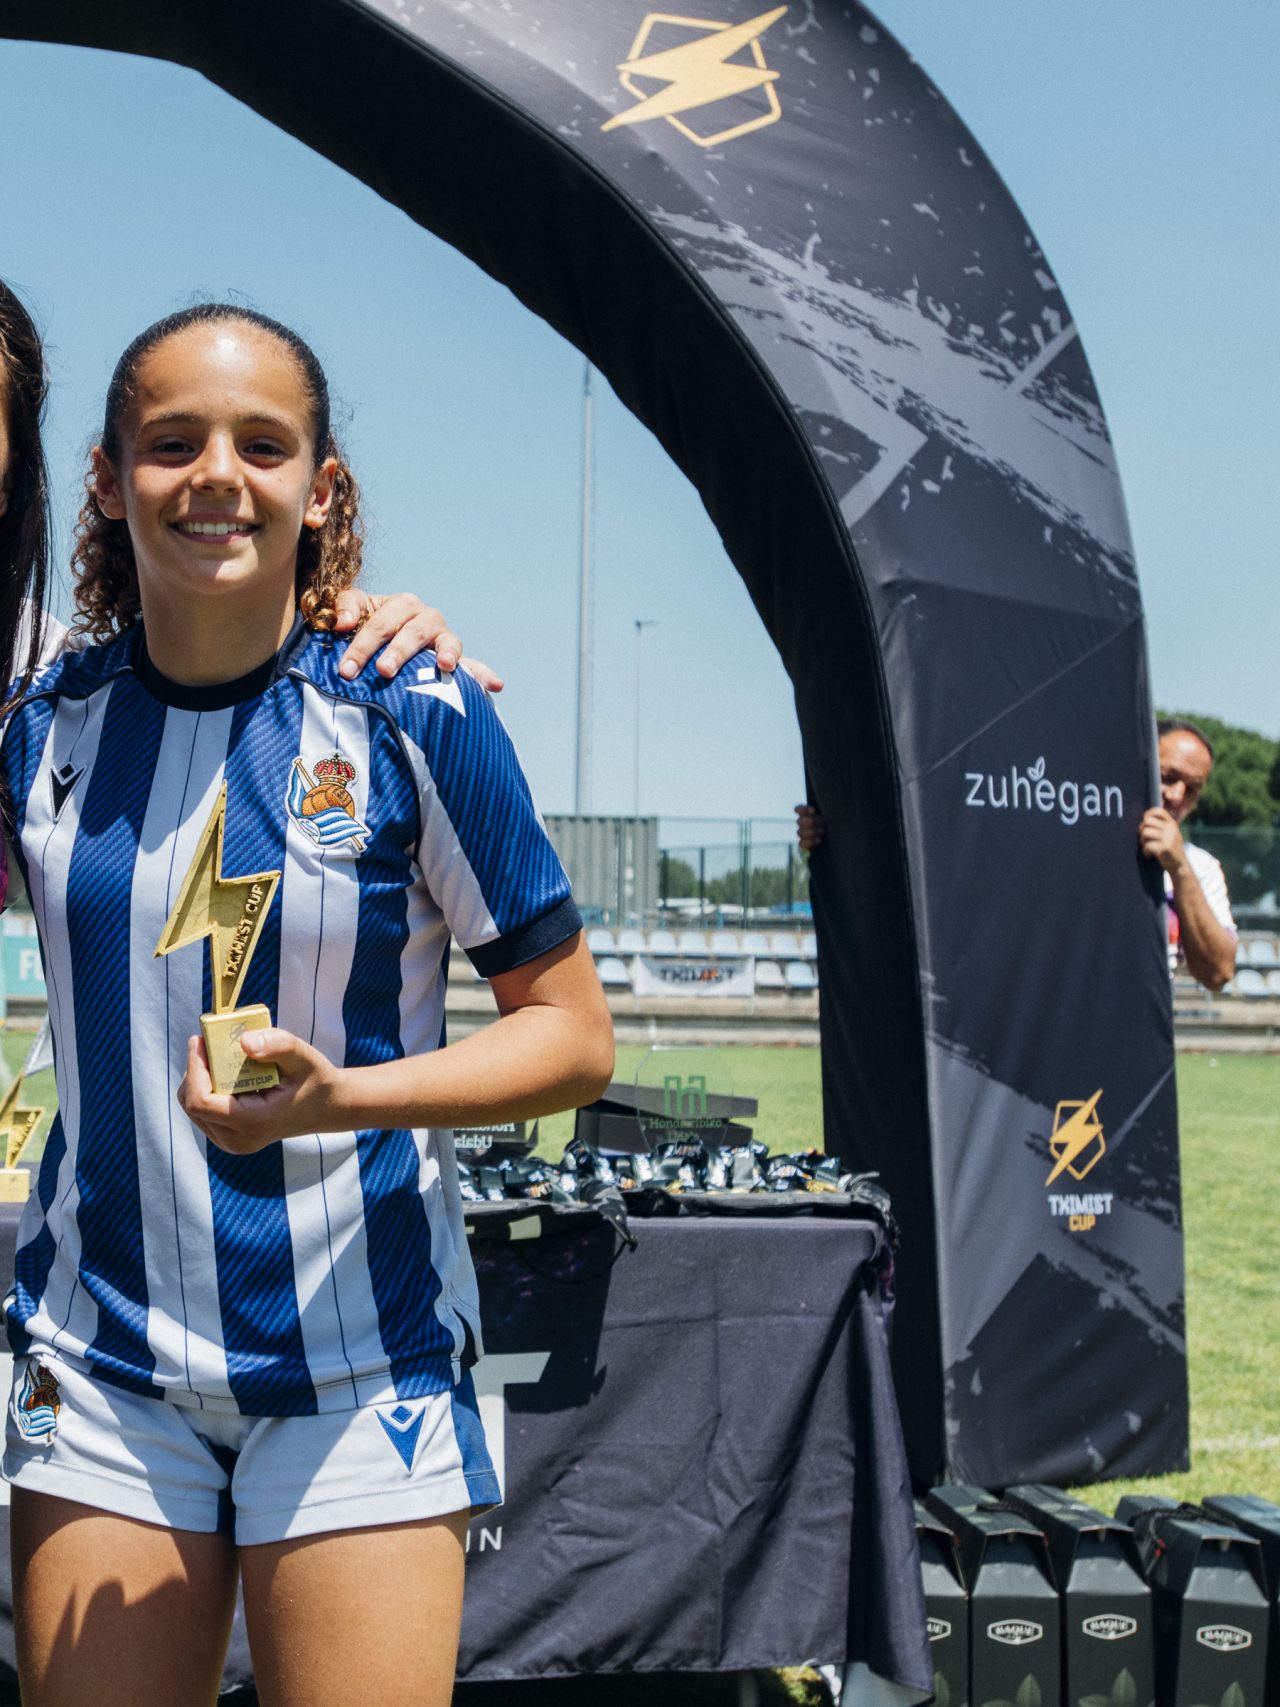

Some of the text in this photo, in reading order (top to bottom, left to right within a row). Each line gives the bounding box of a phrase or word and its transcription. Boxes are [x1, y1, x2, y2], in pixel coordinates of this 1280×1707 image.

[964, 762, 1123, 826] zuhegan
[245, 883, 264, 914] CUP
[1048, 1193, 1113, 1216] TXIMIST
[1069, 1214, 1096, 1232] CUP
